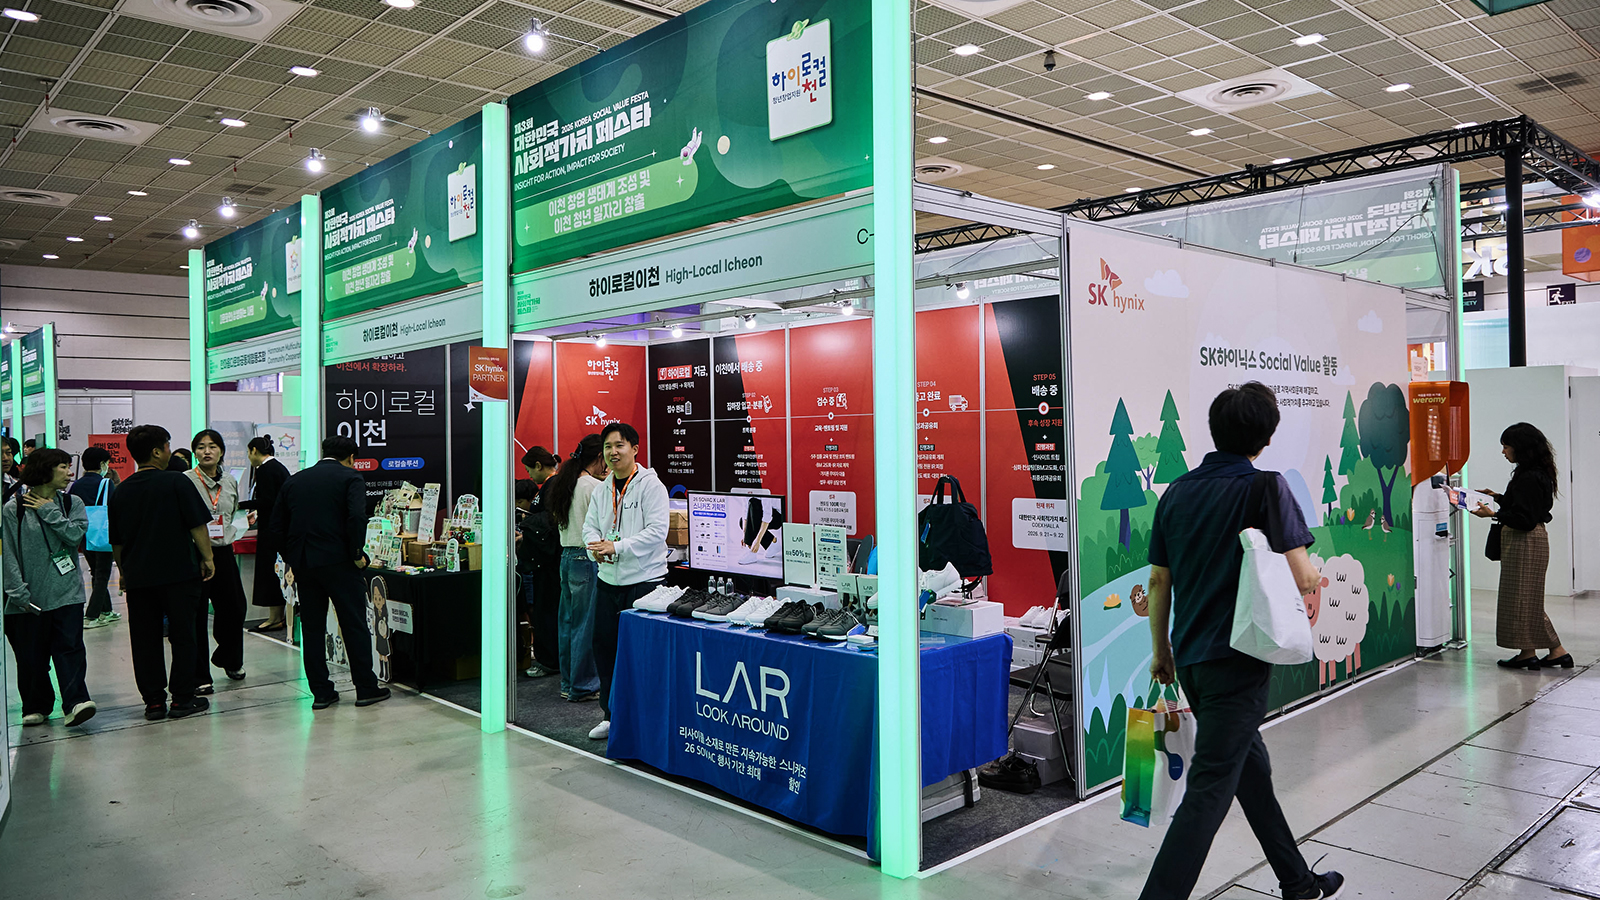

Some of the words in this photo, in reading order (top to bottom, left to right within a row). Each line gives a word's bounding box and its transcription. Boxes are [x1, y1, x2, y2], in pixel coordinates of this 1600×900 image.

[514, 117, 534, 135] 제3회
[561, 122, 574, 134] 2026
[574, 115, 592, 129] KOREA
[593, 106, 612, 120] SOCIAL
[613, 98, 629, 111] VALUE
[631, 90, 649, 104] FESTA
[514, 120, 559, 152] 대한민국
[514, 129, 593, 176] 사회적가치
[596, 101, 651, 145] 페스타
[515, 175, 534, 192] INSIGHT
[534, 173, 544, 184] FOR
[545, 166, 566, 180] ACTION,
[566, 158, 587, 173] IMPACT
[588, 153, 600, 165] FOR
[600, 143, 625, 162] SOCIETY
[549, 195, 565, 216] 이천
[568, 191, 585, 212] 창업
[587, 182, 615, 205] 생태계
[618, 175, 637, 194] 조성
[639, 169, 650, 188] 및
[554, 213, 572, 234] 이천
[574, 210, 592, 229] 청년
[593, 200, 622, 223] 일자리
[624, 193, 645, 213] 창출
[589, 266, 659, 297] 하이로컬이천
[666, 260, 721, 284] High-Local
[724, 254, 763, 271] Icheon
[1088, 283, 1108, 306] SK
[1113, 290, 1144, 313] hynix
[362, 322, 398, 342] 하이로컬이천
[400, 321, 427, 336] High-Local
[428, 319, 446, 328] Icheon
[372, 363, 407, 372] 확장하라.
[485, 364, 503, 373] hynix
[668, 367, 690, 379] 하이로컬
[694, 365, 708, 377] 지금,
[716, 362, 740, 375] 이천에서
[741, 361, 754, 372] 배송
[755, 360, 762, 372] 중
[1200, 347, 1256, 370] SK하이닉스
[1259, 351, 1291, 371] Social
[1294, 354, 1321, 372] Value
[1322, 355, 1338, 376] 활동
[472, 374, 505, 382] PARTNER
[1032, 385, 1048, 396] 배송
[1049, 385, 1058, 396] 중
[336, 389, 435, 416] 하이로컬
[817, 396, 828, 406] 검수
[829, 396, 834, 406] 중
[927, 391, 941, 401] 완료
[337, 419, 387, 447] 이천
[586, 416, 598, 426] SK
[696, 651, 790, 719] LAR
[696, 702, 729, 724] LOOK
[732, 713, 789, 740] AROUND
[685, 742, 695, 753] 26
[696, 746, 716, 763] SOVAC
[746, 765, 761, 781] 최대
[705, 736, 724, 751] 소재로
[726, 742, 739, 757] 만든
[741, 747, 776, 769] 지속가능한
[779, 759, 806, 778] 스니커즈
[788, 777, 800, 794] 할인
